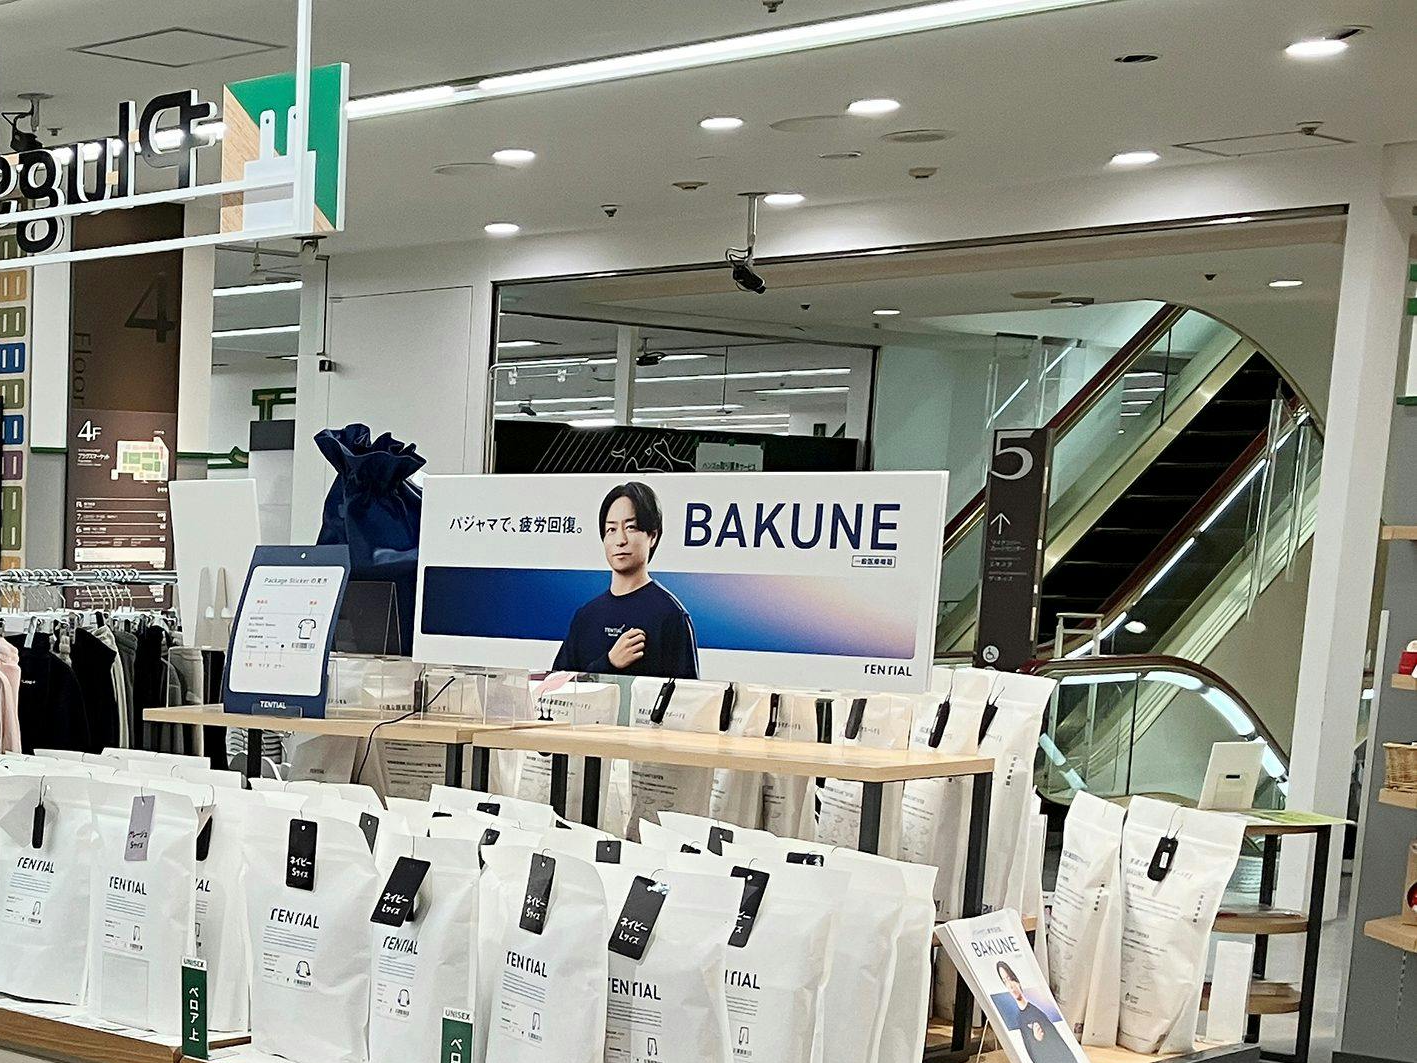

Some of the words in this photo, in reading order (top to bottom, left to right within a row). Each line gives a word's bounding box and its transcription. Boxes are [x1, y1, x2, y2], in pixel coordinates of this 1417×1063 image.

[123, 272, 176, 343] 4
[77, 420, 102, 442] 4F
[991, 429, 1034, 481] 5
[449, 515, 583, 535] パジャマで、疲労回復。
[683, 501, 902, 552] BAKUNE
[264, 576, 288, 585] Package
[289, 576, 310, 585] Sticker
[864, 662, 912, 678] TENTIAL
[259, 700, 287, 710] TENTIAL
[17, 856, 55, 875] TENTIAL
[289, 855, 312, 868] ネイビー
[291, 867, 309, 879] Sサイズ
[108, 876, 148, 896] TENTIAL
[383, 892, 410, 904] ネイビー
[526, 894, 547, 908] ネイビー
[269, 907, 321, 930] TENTIAL
[381, 903, 400, 916] Lサイズ
[620, 916, 649, 933] ネイビー
[382, 935, 418, 955] TENTIAL
[618, 930, 640, 946] Lサイズ
[970, 936, 1020, 958] BAKUNE
[506, 950, 548, 978] TENTIAL
[608, 976, 662, 1001] ENTIAL
[724, 969, 761, 990] TIAL
[444, 1009, 471, 1021] UNISEX
